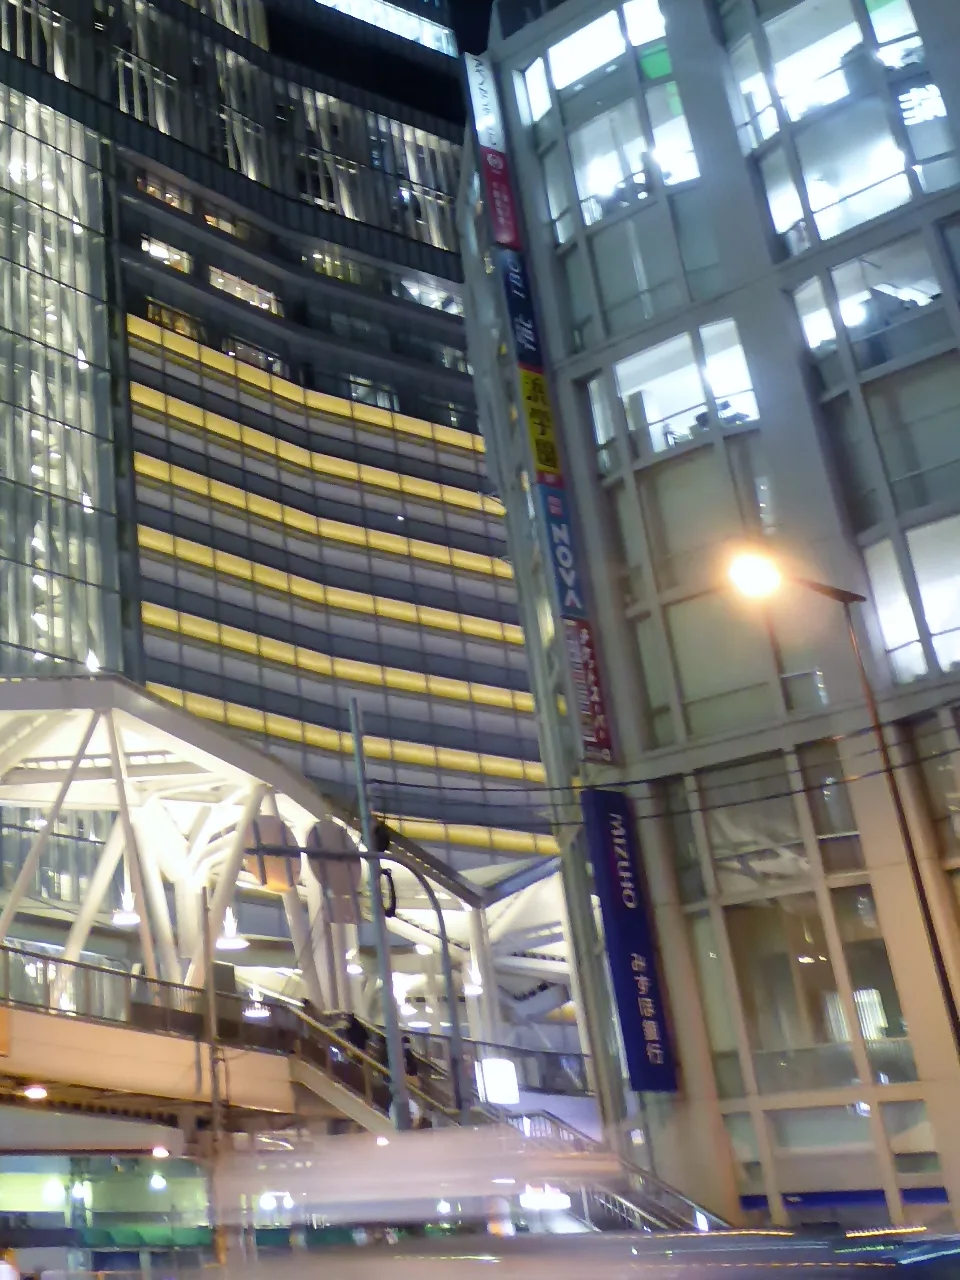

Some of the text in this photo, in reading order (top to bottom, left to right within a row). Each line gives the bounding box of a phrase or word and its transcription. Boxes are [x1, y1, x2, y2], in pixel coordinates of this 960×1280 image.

[551, 523, 582, 609] NOVA
[608, 812, 638, 909] MIZUHO
[630, 952, 665, 1065] みずほ銀行
